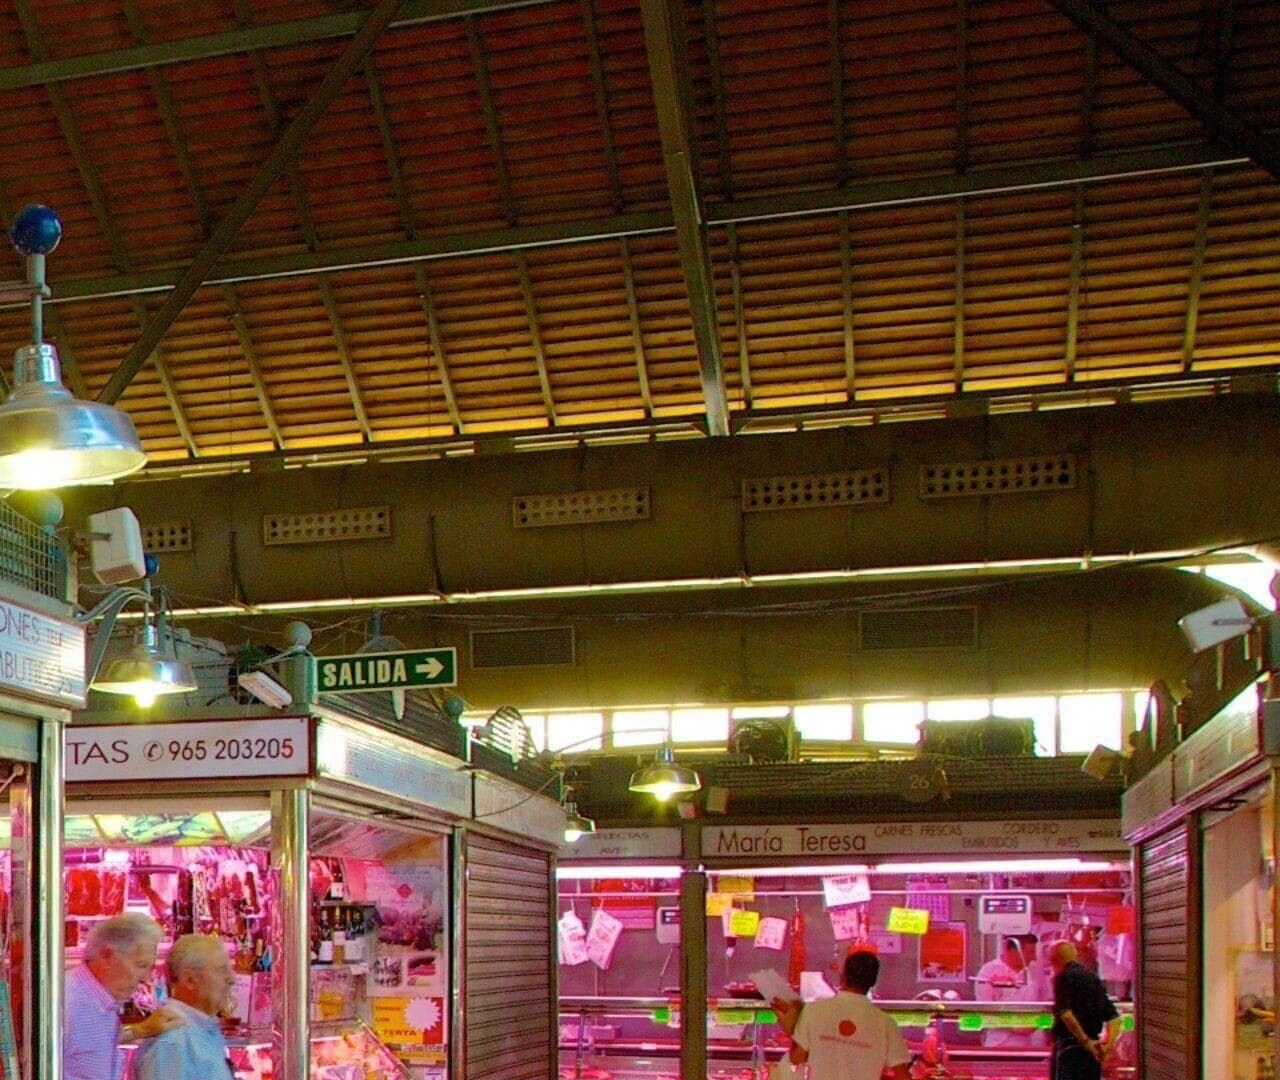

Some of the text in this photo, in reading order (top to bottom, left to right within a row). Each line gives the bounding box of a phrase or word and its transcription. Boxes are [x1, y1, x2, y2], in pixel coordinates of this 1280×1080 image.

[322, 658, 408, 688] SALIDA
[168, 740, 208, 762] 965
[214, 738, 295, 761] 203205
[717, 827, 867, 854] María Teresa
[874, 825, 913, 837] CARNES
[919, 824, 963, 837] FRESCAS
